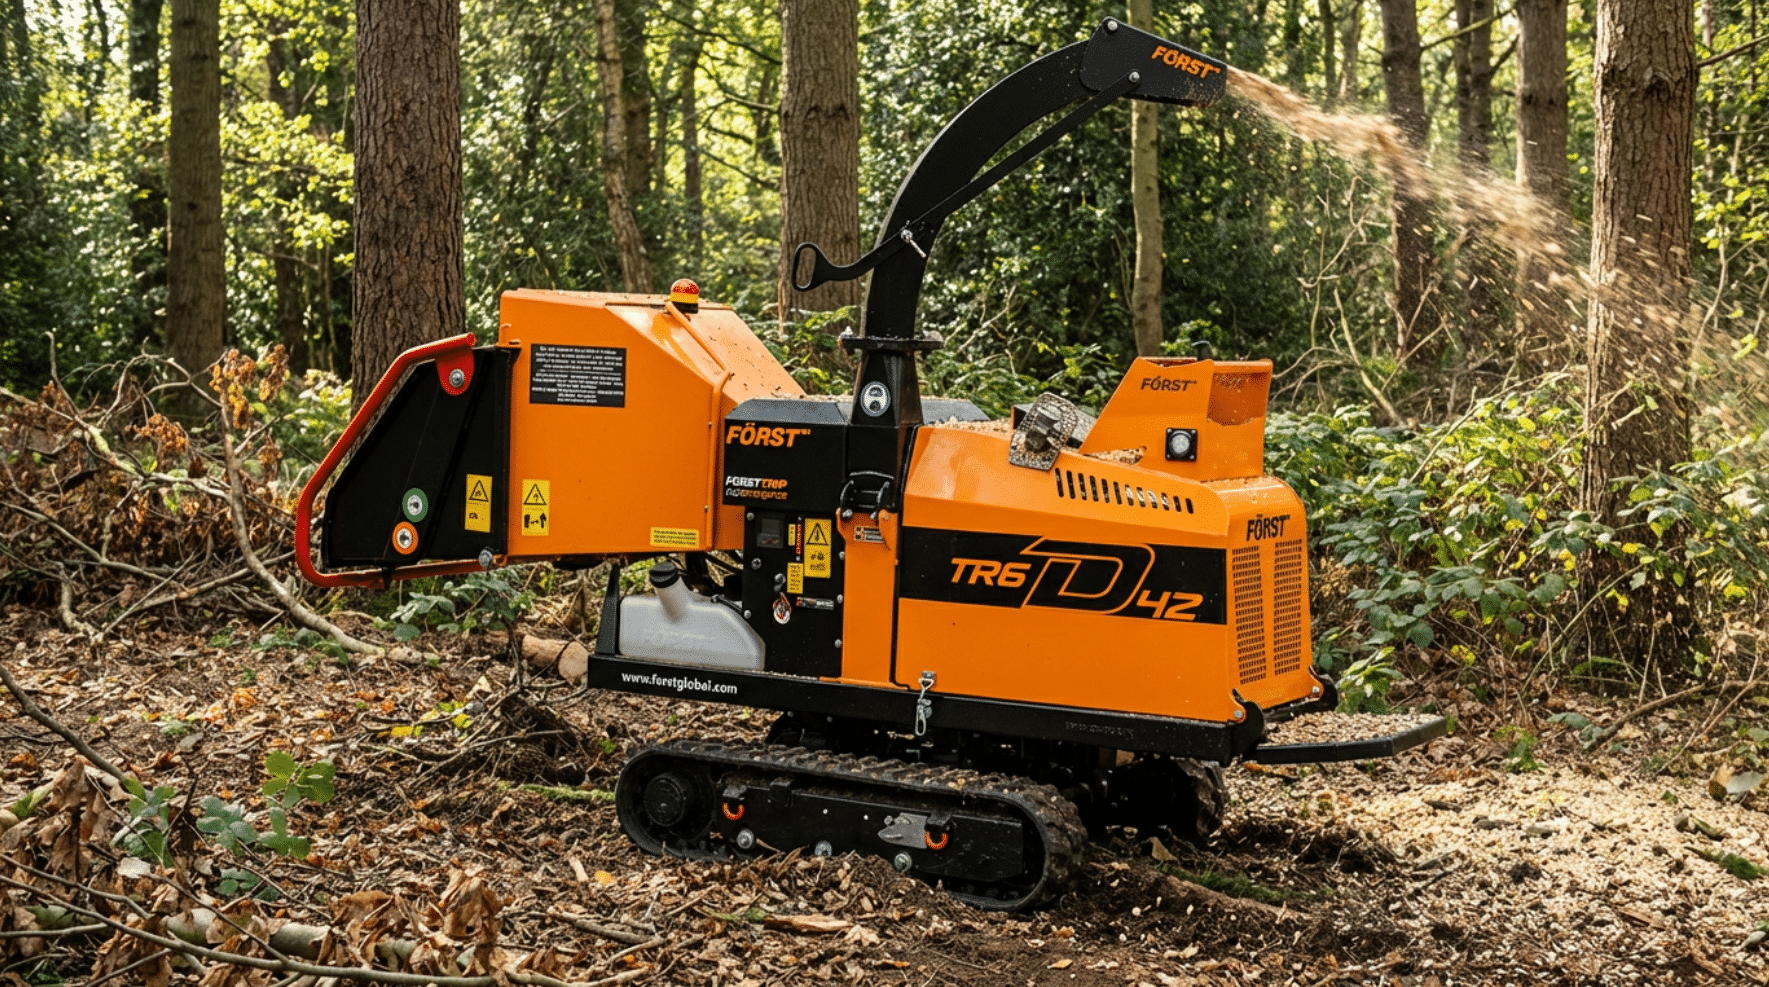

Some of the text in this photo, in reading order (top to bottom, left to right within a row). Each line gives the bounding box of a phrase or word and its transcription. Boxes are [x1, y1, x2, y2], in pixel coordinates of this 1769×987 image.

[725, 422, 802, 447] FÖRST
[1246, 513, 1288, 541] FÖRST
[951, 557, 1032, 588] TR6
[1136, 590, 1204, 621] 42
